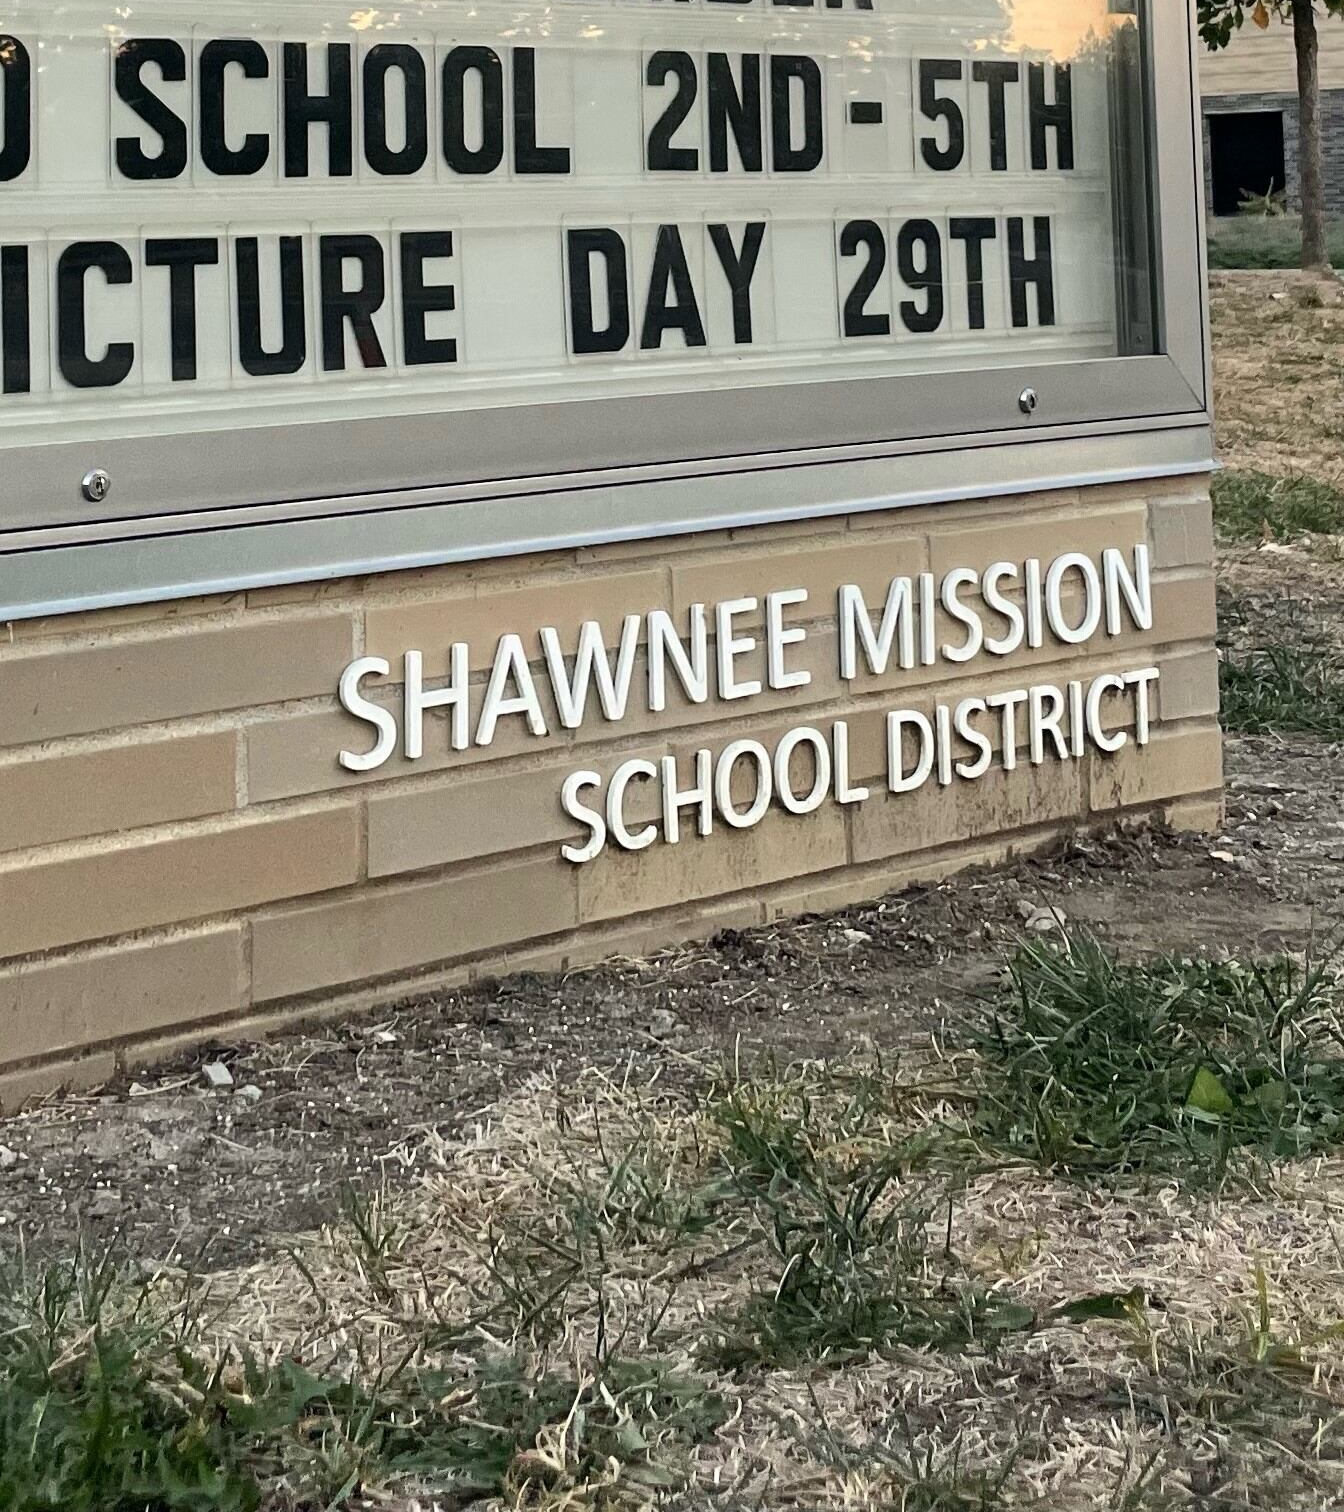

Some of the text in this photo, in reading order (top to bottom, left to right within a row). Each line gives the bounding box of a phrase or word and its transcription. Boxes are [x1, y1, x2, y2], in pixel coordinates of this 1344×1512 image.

[114, 37, 571, 181] SCHOOL
[567, 221, 766, 355] DAY
[839, 216, 1056, 339] 29TH
[339, 543, 1154, 772] SHAWNEE MISSION
[560, 667, 1160, 864] SCHOOL DISTRICT
